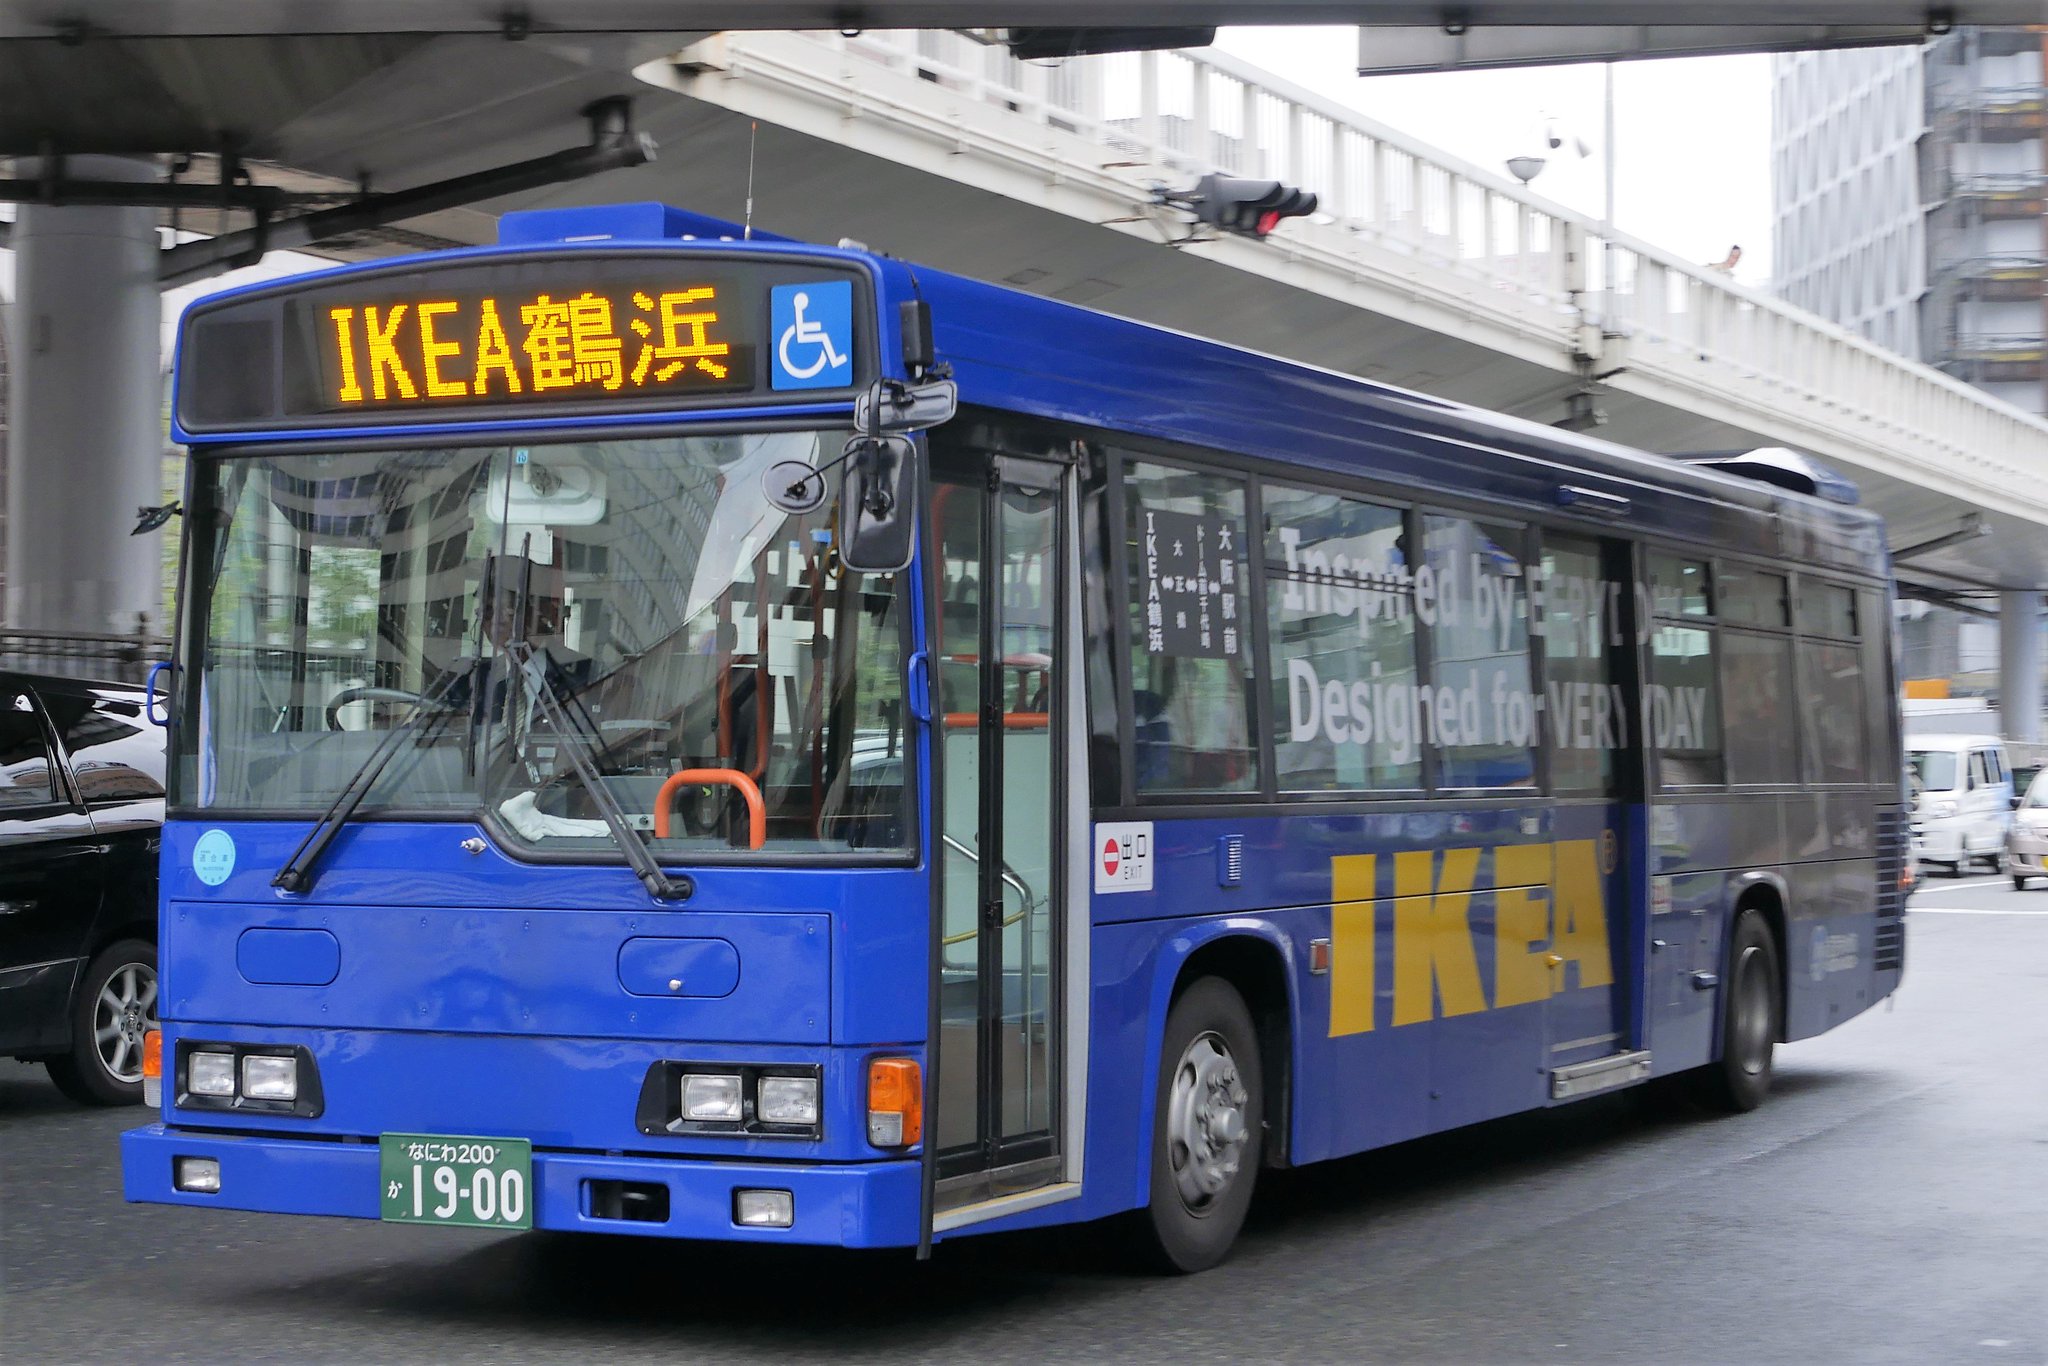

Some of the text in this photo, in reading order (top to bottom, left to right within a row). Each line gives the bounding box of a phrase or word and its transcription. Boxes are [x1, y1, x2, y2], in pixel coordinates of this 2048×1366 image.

[331, 287, 728, 402] IKEA鶴浜
[1279, 527, 1459, 639] Inspired
[1471, 553, 1516, 651] by
[1288, 659, 1482, 764] Designed
[1491, 670, 1545, 748] for
[1122, 834, 1147, 859] 出口
[1124, 865, 1142, 880] EXIT
[1328, 839, 1614, 1038] IKEA
[387, 1165, 524, 1222] か 19-00
